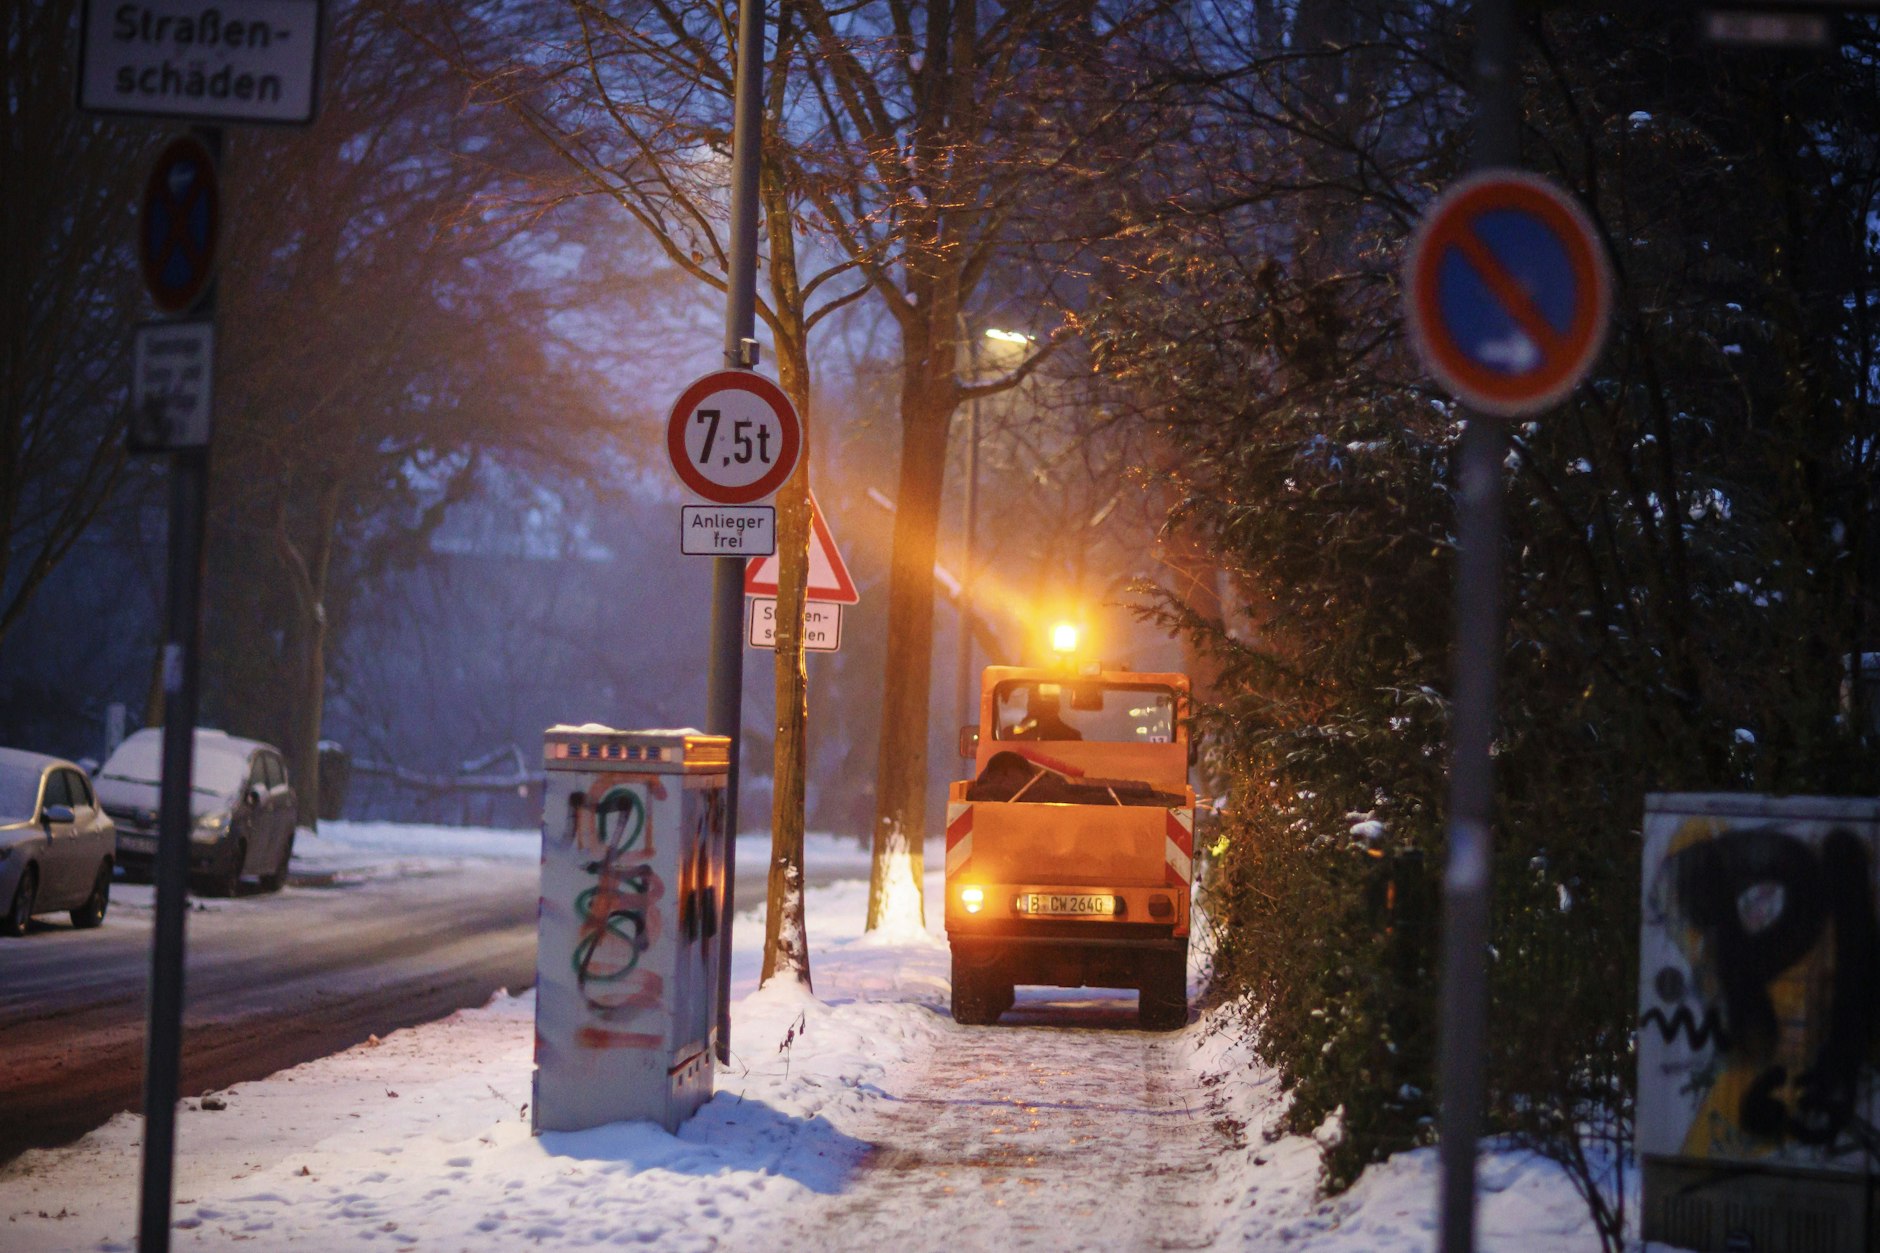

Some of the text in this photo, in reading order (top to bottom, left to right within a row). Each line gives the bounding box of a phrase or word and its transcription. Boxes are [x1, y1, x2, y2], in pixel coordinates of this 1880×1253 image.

[113, 3, 290, 48] Straßen-
[115, 60, 281, 102] schäden
[697, 410, 770, 467] 7,5t
[692, 514, 764, 531] Anlieger
[714, 531, 742, 547] frei
[763, 606, 829, 622] Sen-
[1070, 897, 1103, 912] 2640
